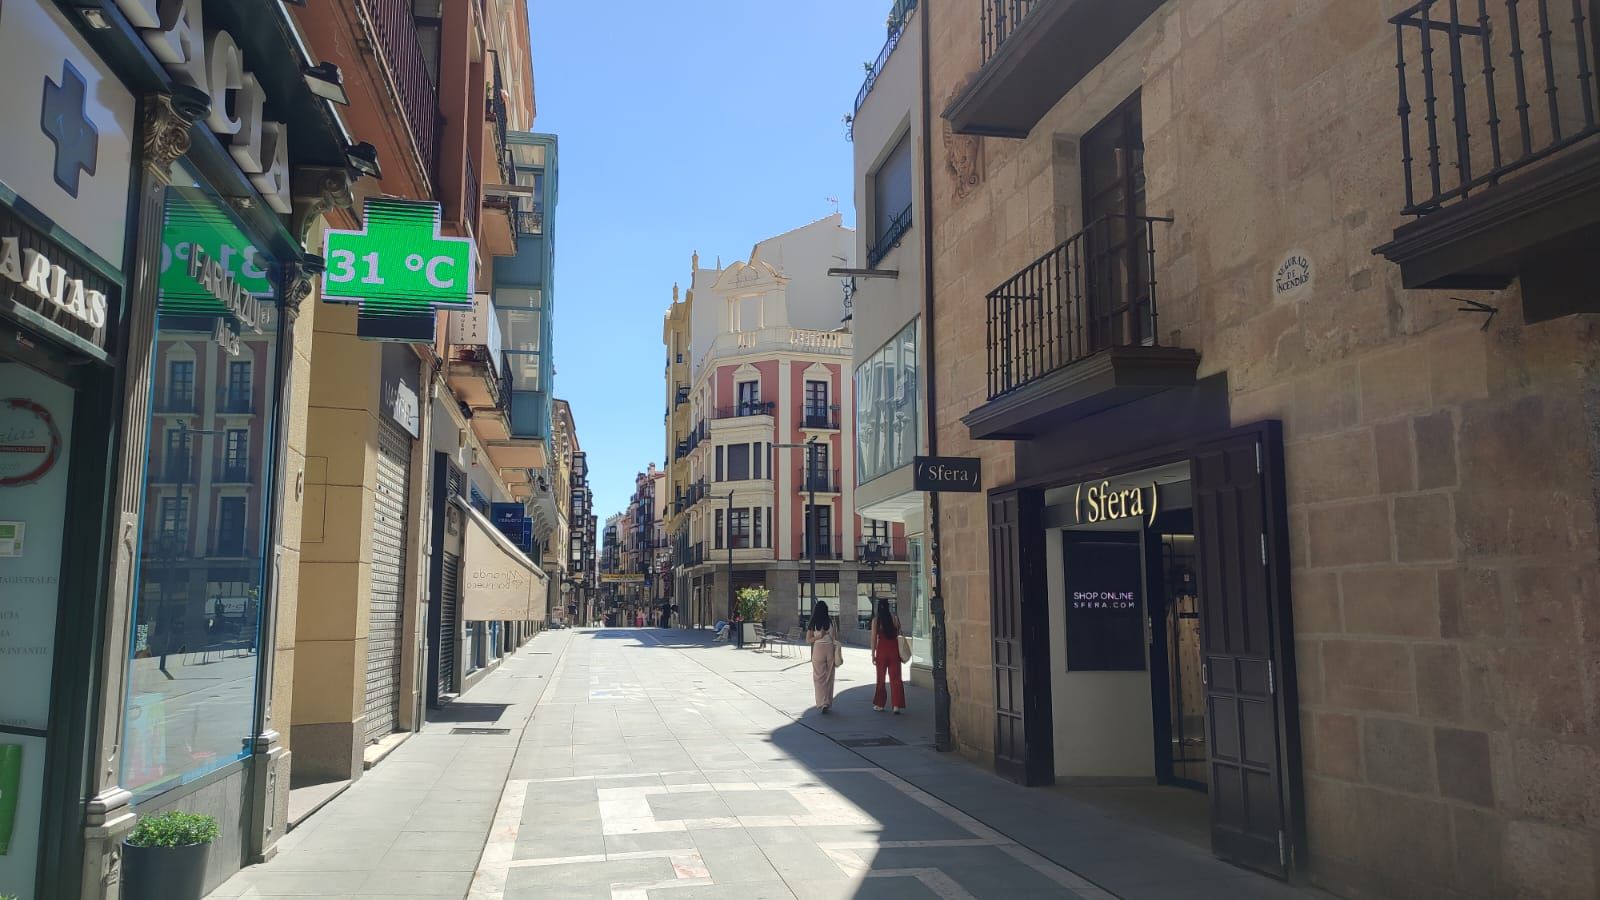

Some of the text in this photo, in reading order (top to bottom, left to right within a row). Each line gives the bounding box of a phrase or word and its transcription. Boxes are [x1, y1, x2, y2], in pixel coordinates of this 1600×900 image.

[329, 249, 455, 289] 31 °C
[1287, 269, 1297, 280] DE
[0, 236, 107, 328] ARIAS
[1073, 591, 1134, 601] SHOP ONLINE
